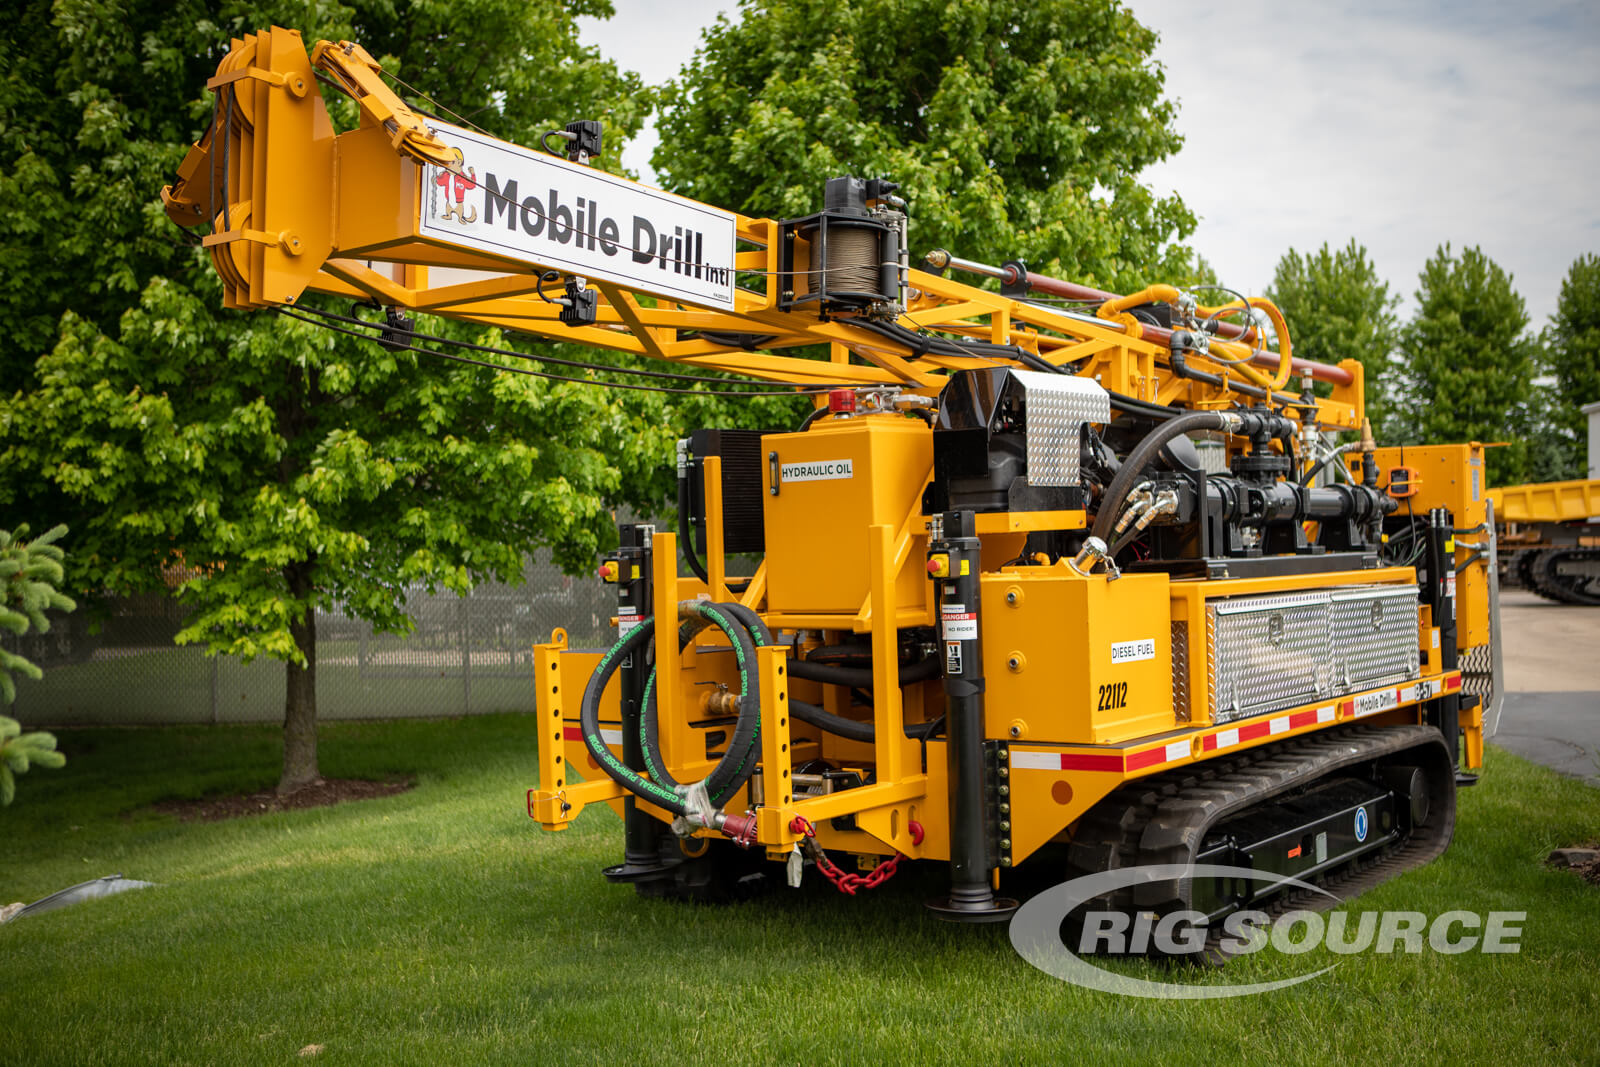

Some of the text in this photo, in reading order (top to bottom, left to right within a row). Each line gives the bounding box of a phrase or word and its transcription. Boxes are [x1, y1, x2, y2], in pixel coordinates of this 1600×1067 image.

[484, 172, 620, 257] Mobile
[632, 215, 703, 280] Drill
[782, 463, 852, 478] HYDRAULIC OIL
[943, 613, 970, 621] DANGER
[1112, 643, 1154, 659] DIESEL FUEL
[1097, 681, 1128, 712] 22112
[1415, 680, 1432, 701] B-57
[1360, 695, 1379, 713] Mobile
[603, 753, 638, 783] PURPOSE
[639, 778, 679, 803] GENERAL
